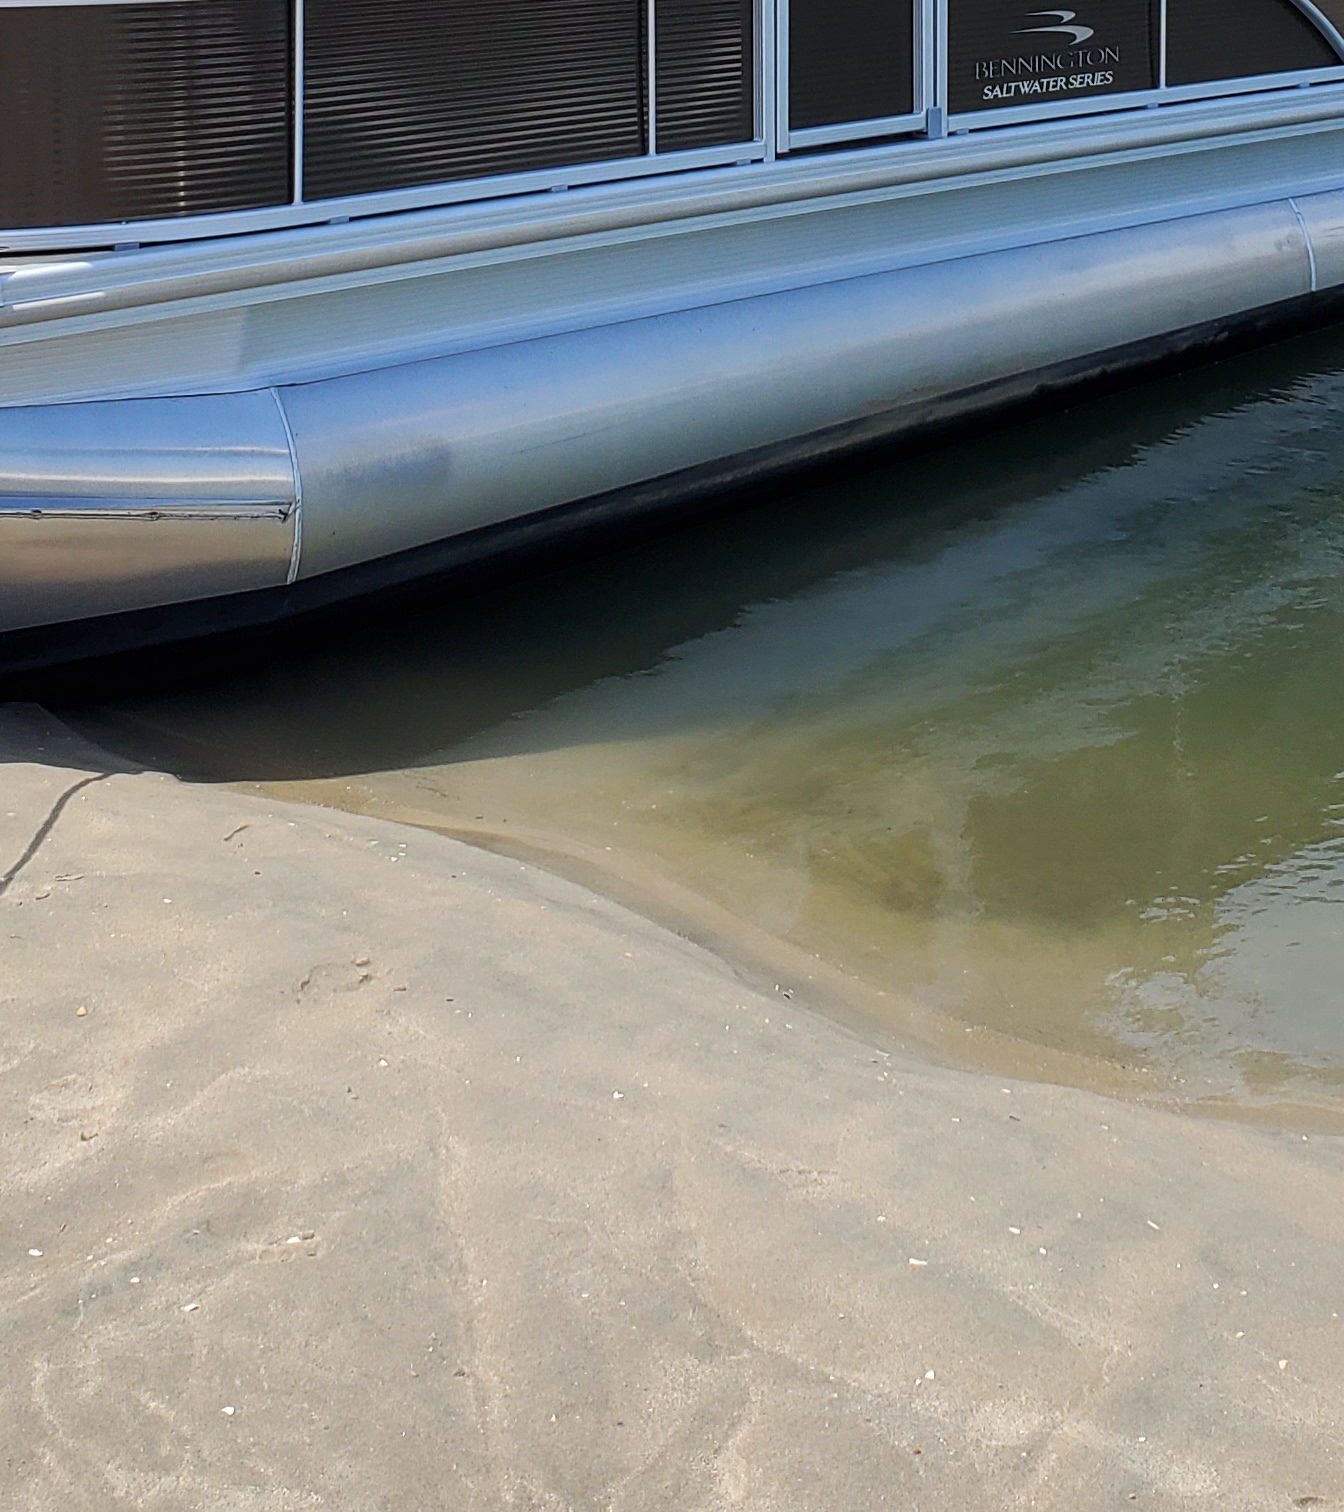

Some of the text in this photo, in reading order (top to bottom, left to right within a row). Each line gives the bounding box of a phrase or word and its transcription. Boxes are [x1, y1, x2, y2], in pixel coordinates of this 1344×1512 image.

[975, 46, 1120, 80] BENNINGTON
[982, 70, 1113, 100] SALTWATER SERIES
